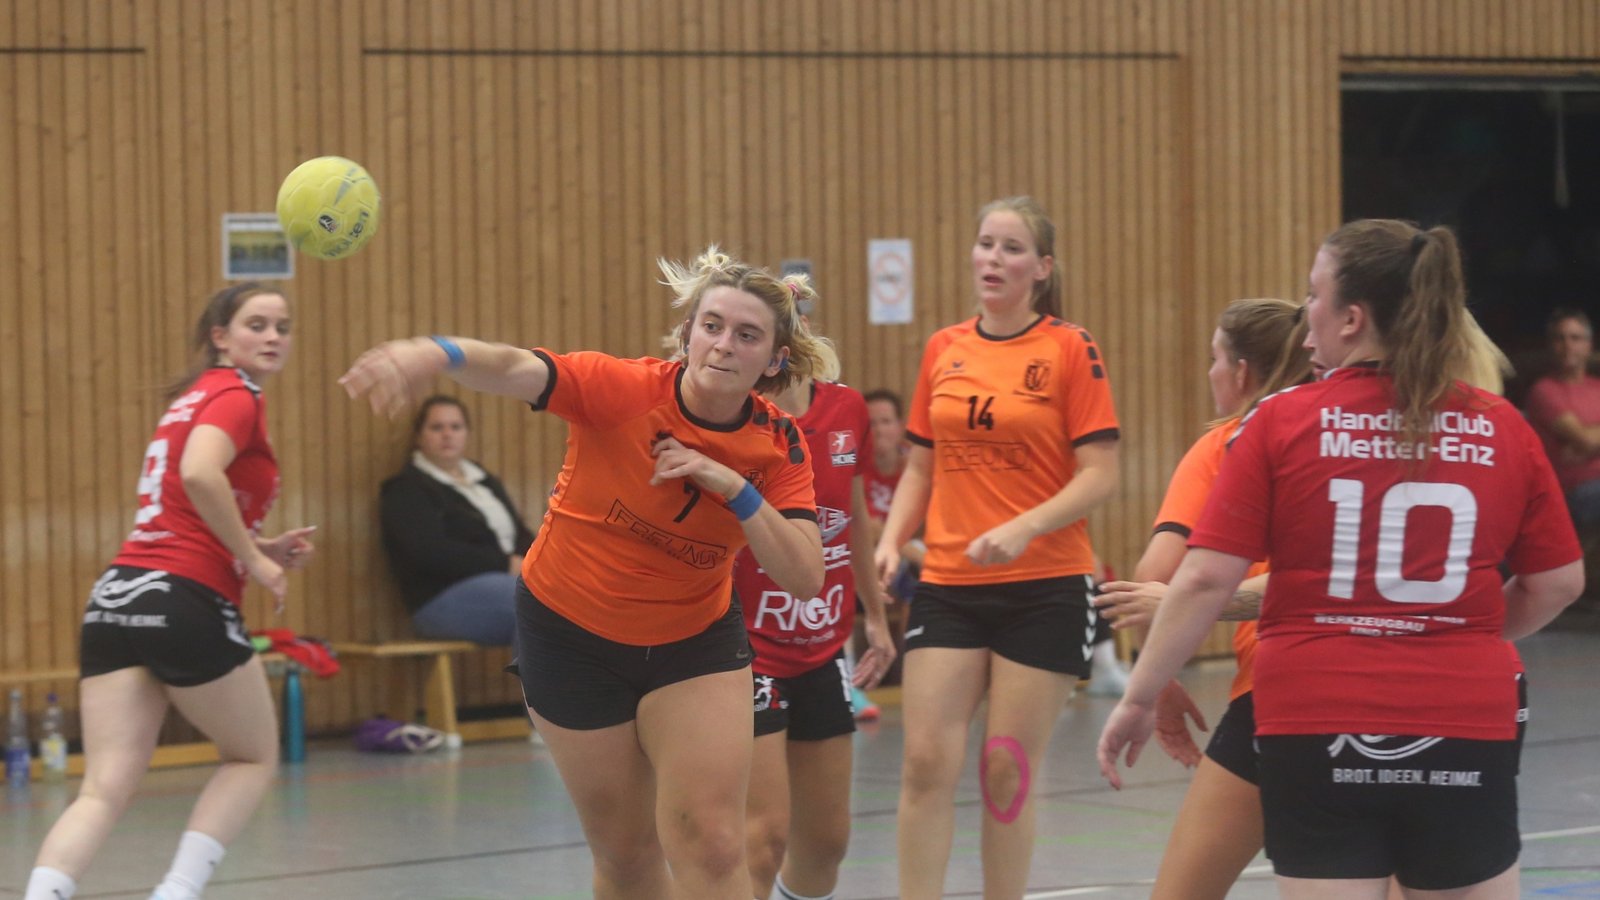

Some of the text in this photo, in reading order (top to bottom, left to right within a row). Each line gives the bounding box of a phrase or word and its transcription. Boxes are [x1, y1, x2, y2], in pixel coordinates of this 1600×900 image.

[967, 395, 996, 430] 14
[1320, 406, 1495, 437] HandblClub
[1319, 431, 1495, 466] Metter-Enz
[673, 481, 701, 523] 7
[1328, 478, 1478, 604] 10
[1332, 768, 1482, 787] BROT. IDEEN. HEIMAT.
